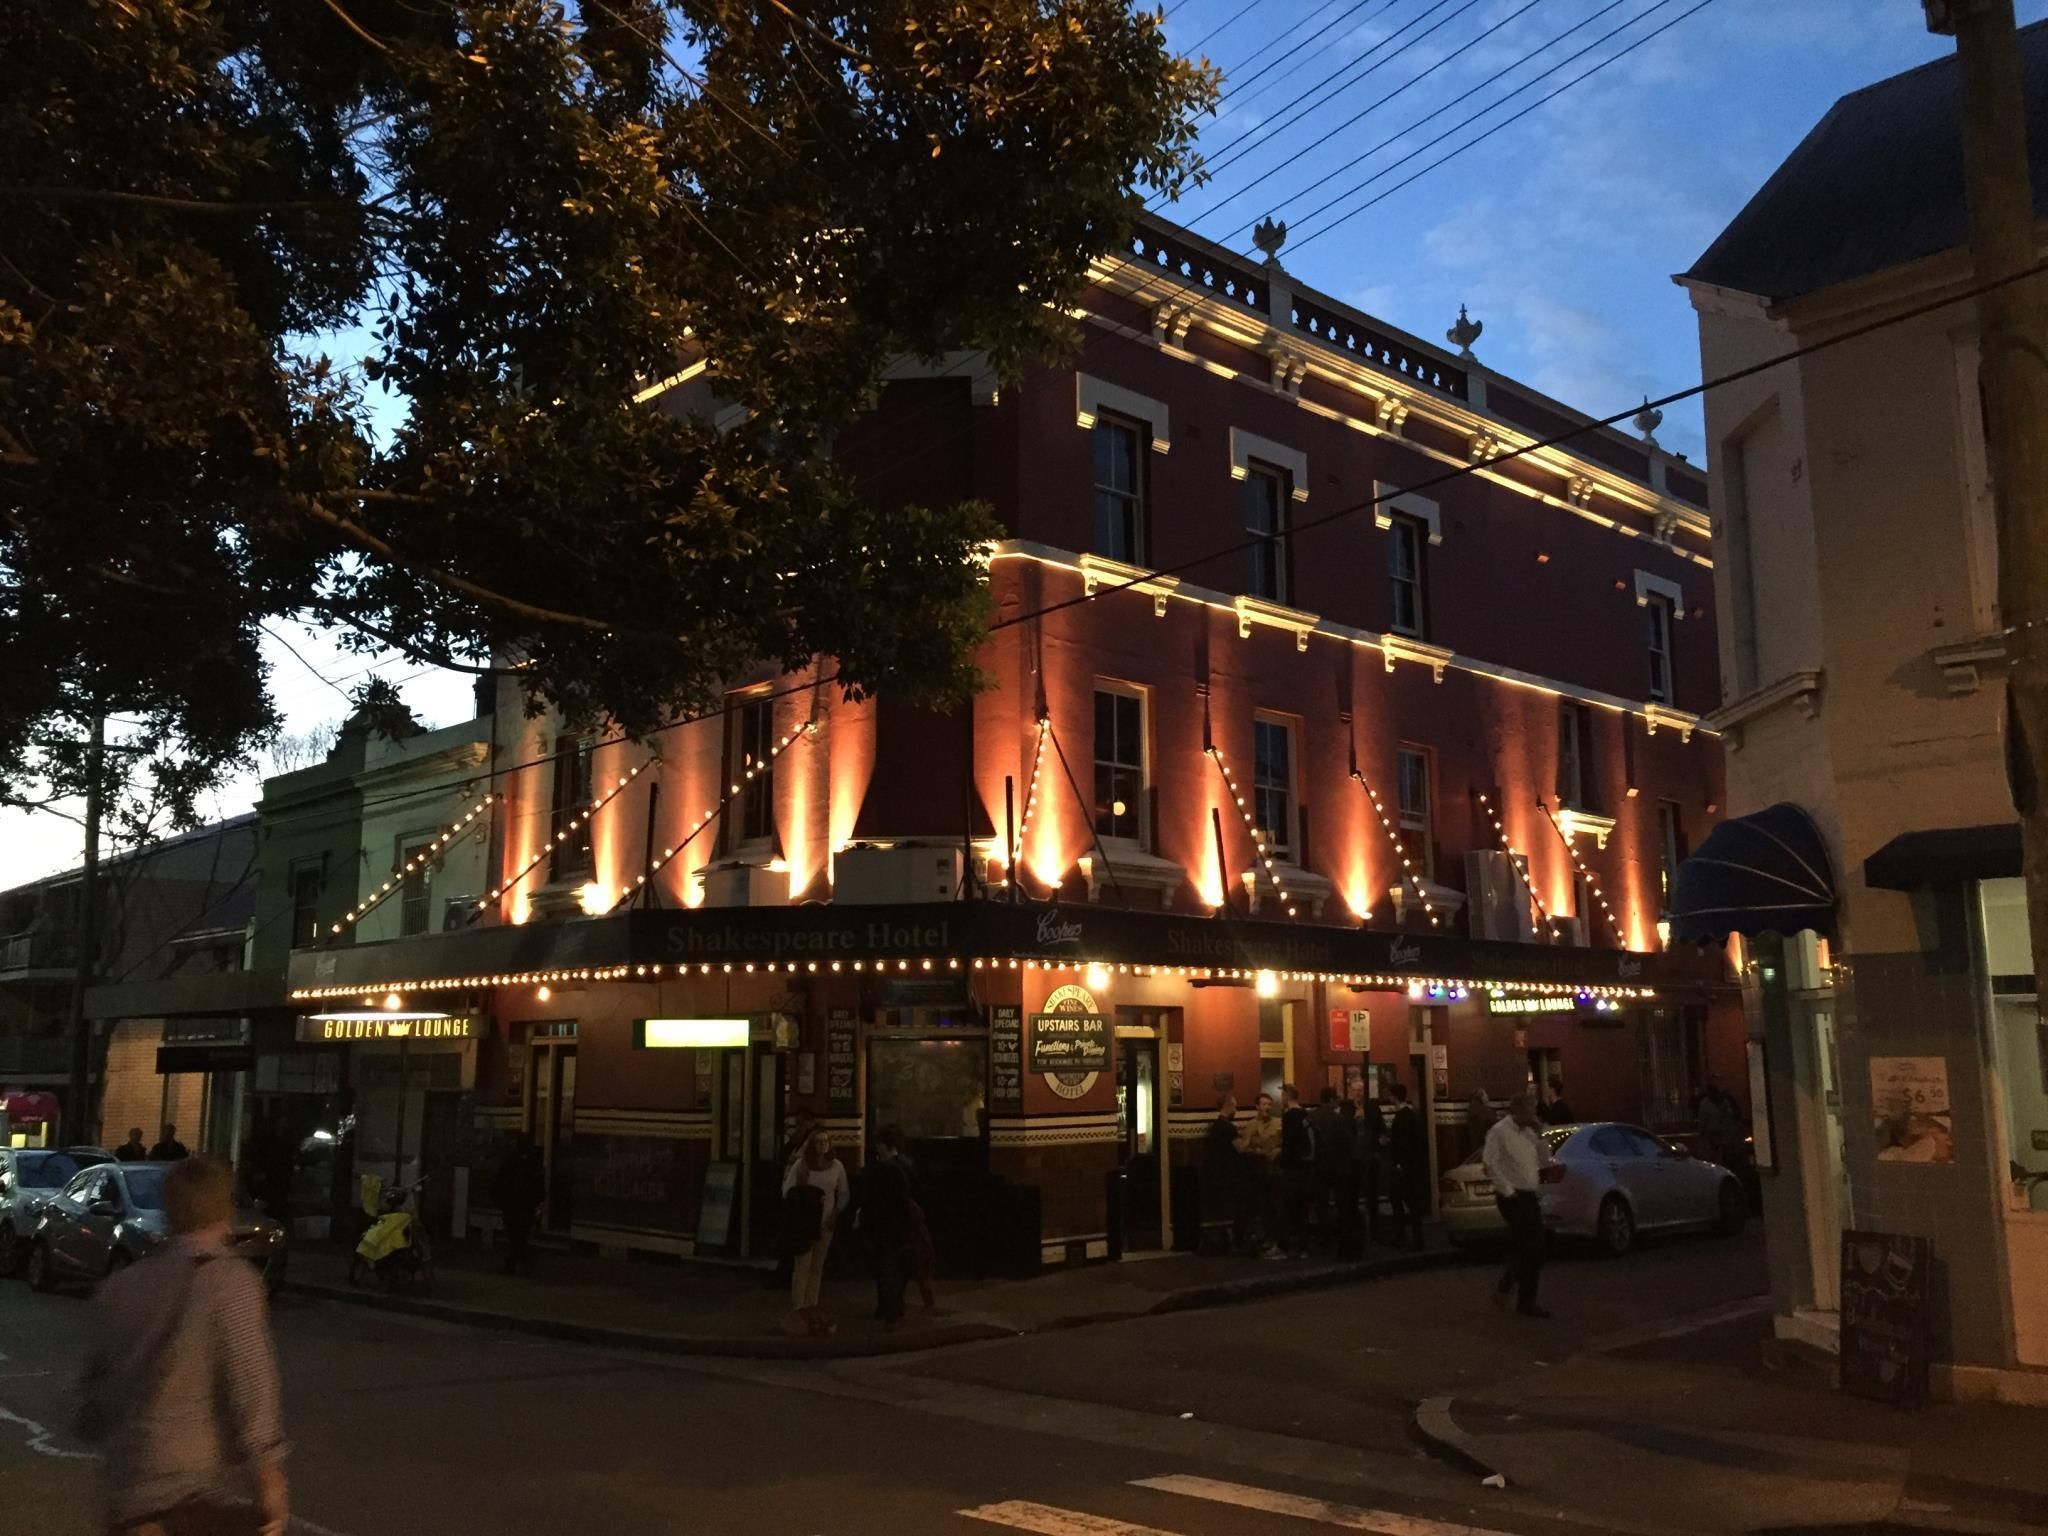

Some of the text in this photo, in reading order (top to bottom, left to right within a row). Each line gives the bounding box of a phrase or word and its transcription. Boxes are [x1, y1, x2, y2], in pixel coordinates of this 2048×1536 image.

[667, 921, 949, 954] Shakespeare Hotel
[1167, 929, 1280, 962] Shakespeare
[1489, 997, 1576, 1013] GOLDEN LOUNGE
[1037, 1019, 1103, 1032] UPSTAIRS BAR
[1353, 1013, 1366, 1023] 1P
[324, 1018, 469, 1038] GOLDEN LOUNGE
[1055, 1083, 1084, 1097] HOTEL
